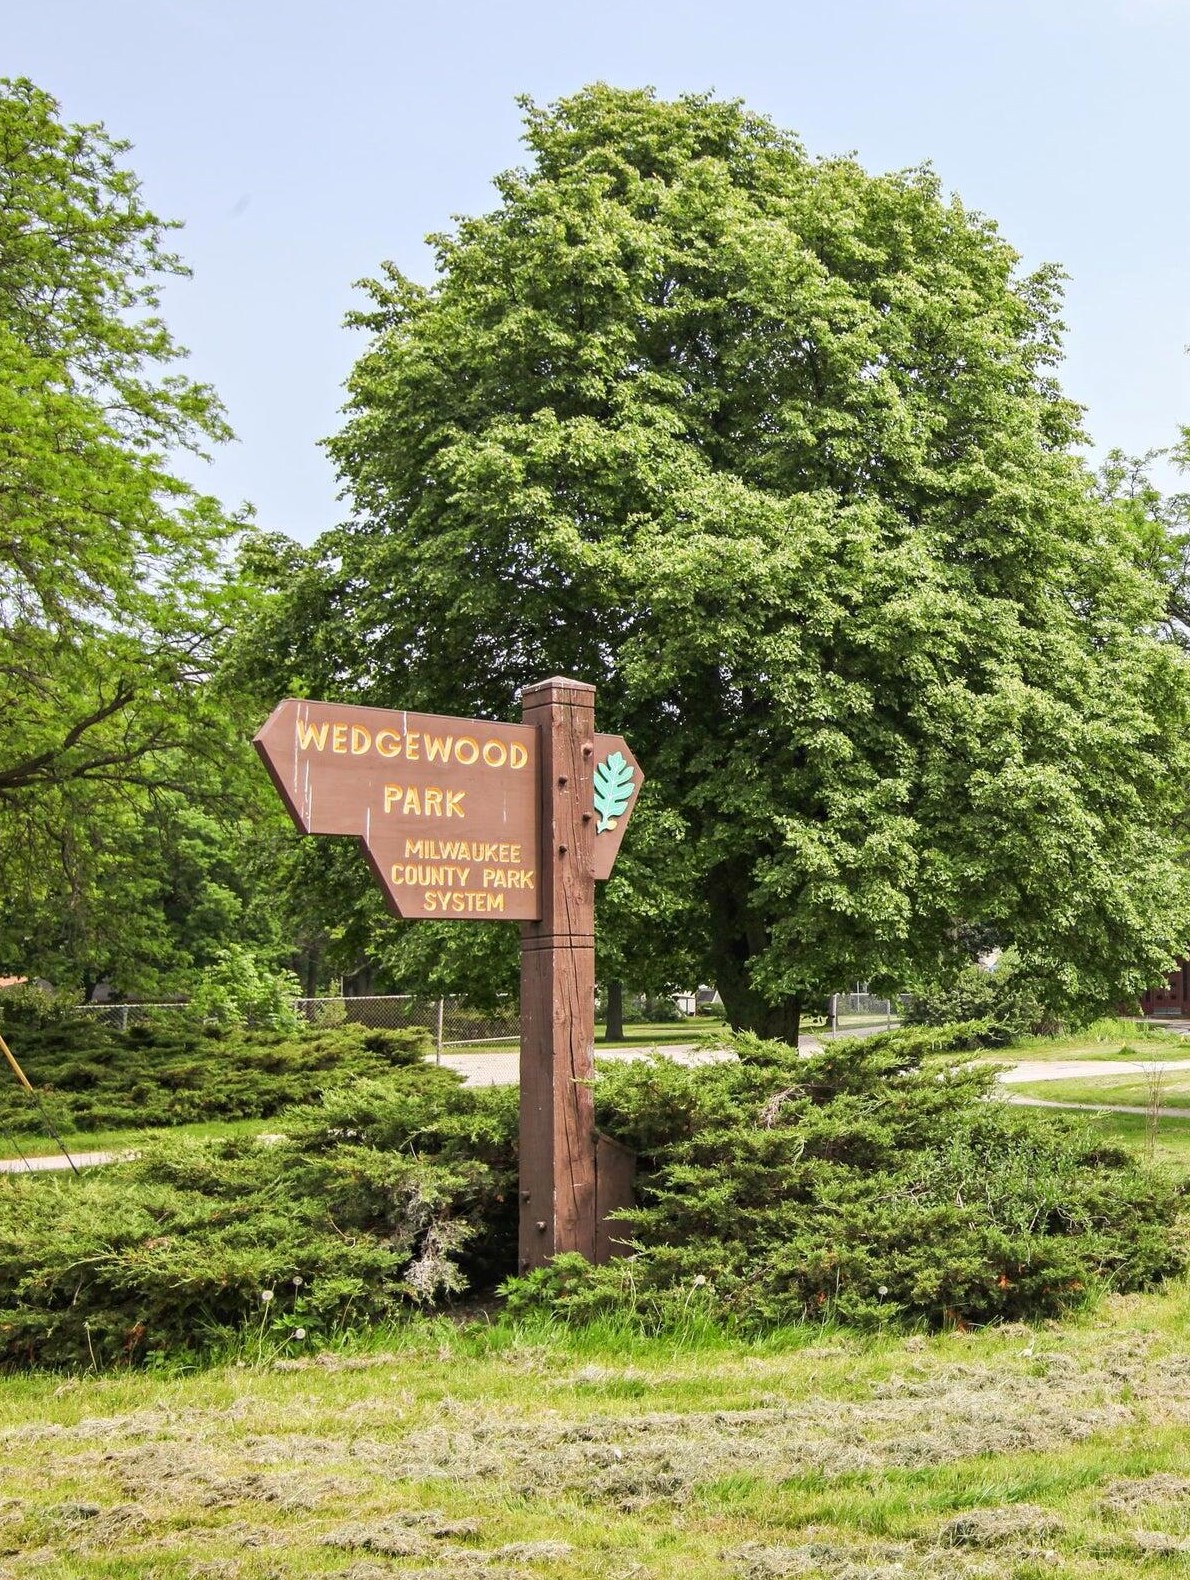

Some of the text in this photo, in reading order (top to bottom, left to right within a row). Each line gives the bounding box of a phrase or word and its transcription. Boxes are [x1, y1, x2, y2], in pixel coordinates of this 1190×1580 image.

[297, 720, 528, 769] WEDGEWOOD
[384, 784, 467, 818] PARK
[404, 838, 522, 862] MILWAUKEE
[391, 863, 535, 889] COUNTY PARK
[423, 892, 504, 912] SYSTEM
